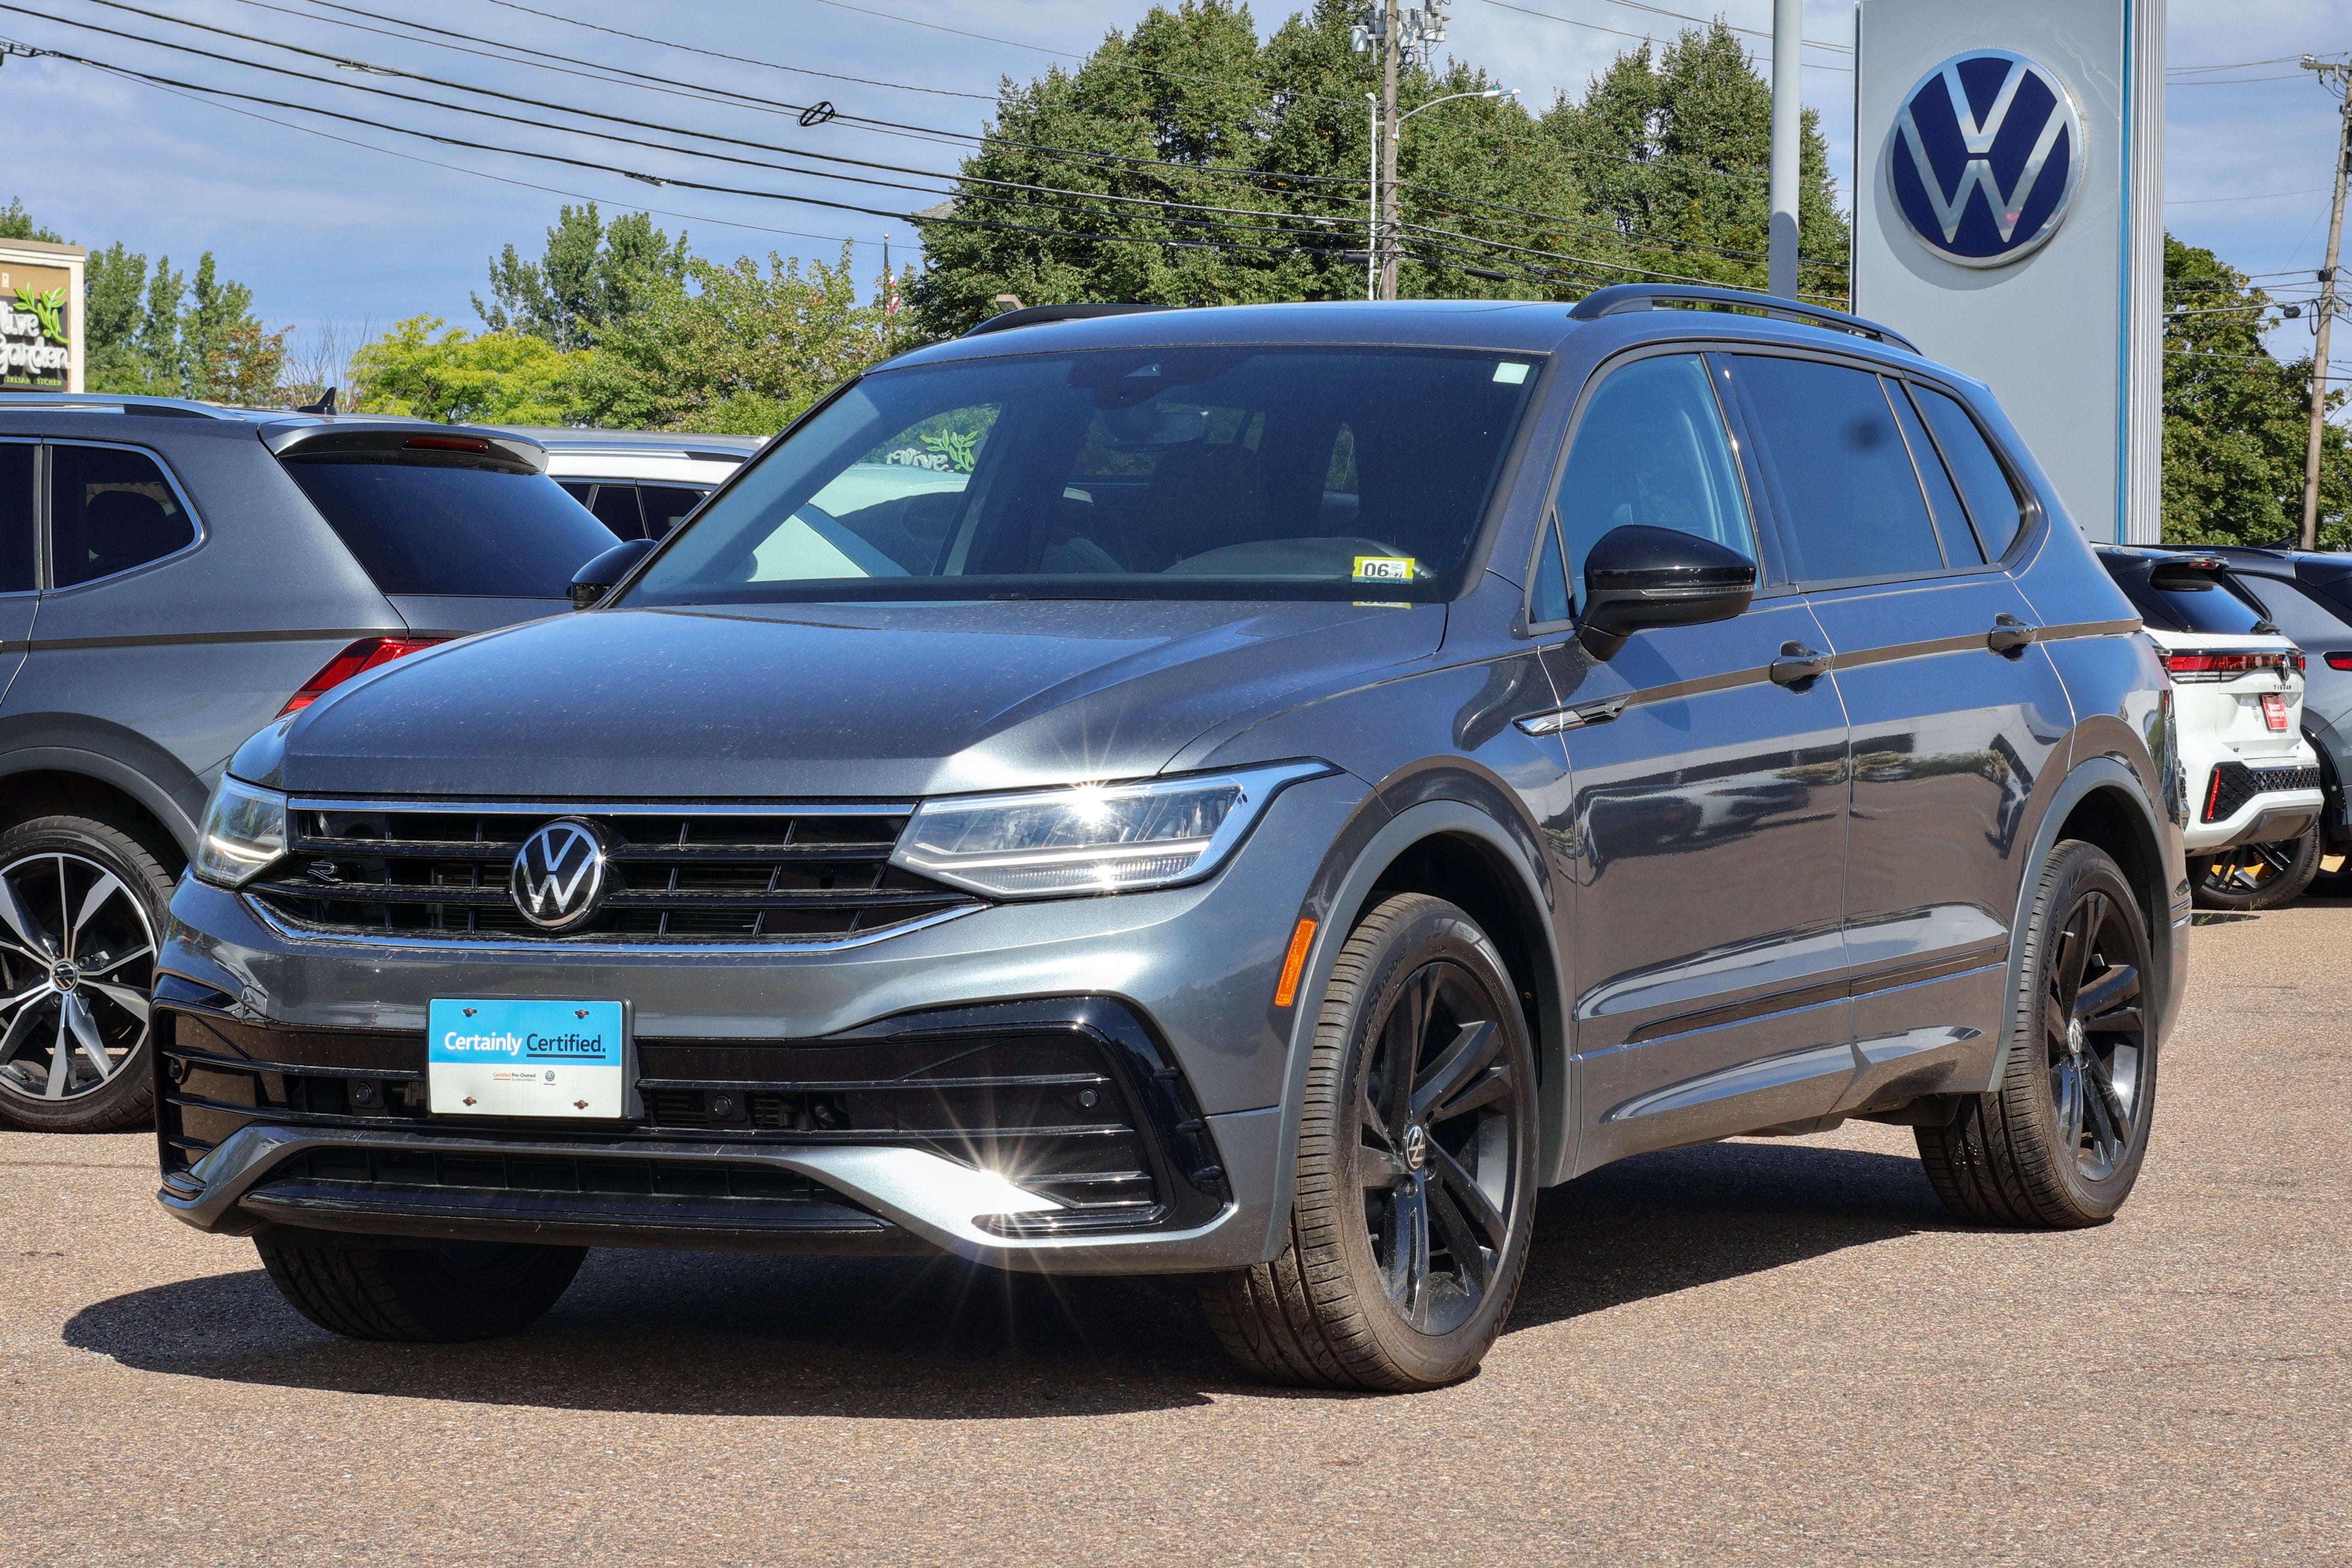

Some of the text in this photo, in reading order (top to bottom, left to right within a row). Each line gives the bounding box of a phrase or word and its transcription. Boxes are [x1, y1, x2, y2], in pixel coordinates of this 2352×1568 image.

[0, 301, 39, 337] live
[1364, 563, 1390, 577] 06
[1381, 948, 1408, 990] noble
[444, 1031, 606, 1056] Certainly Certified.
